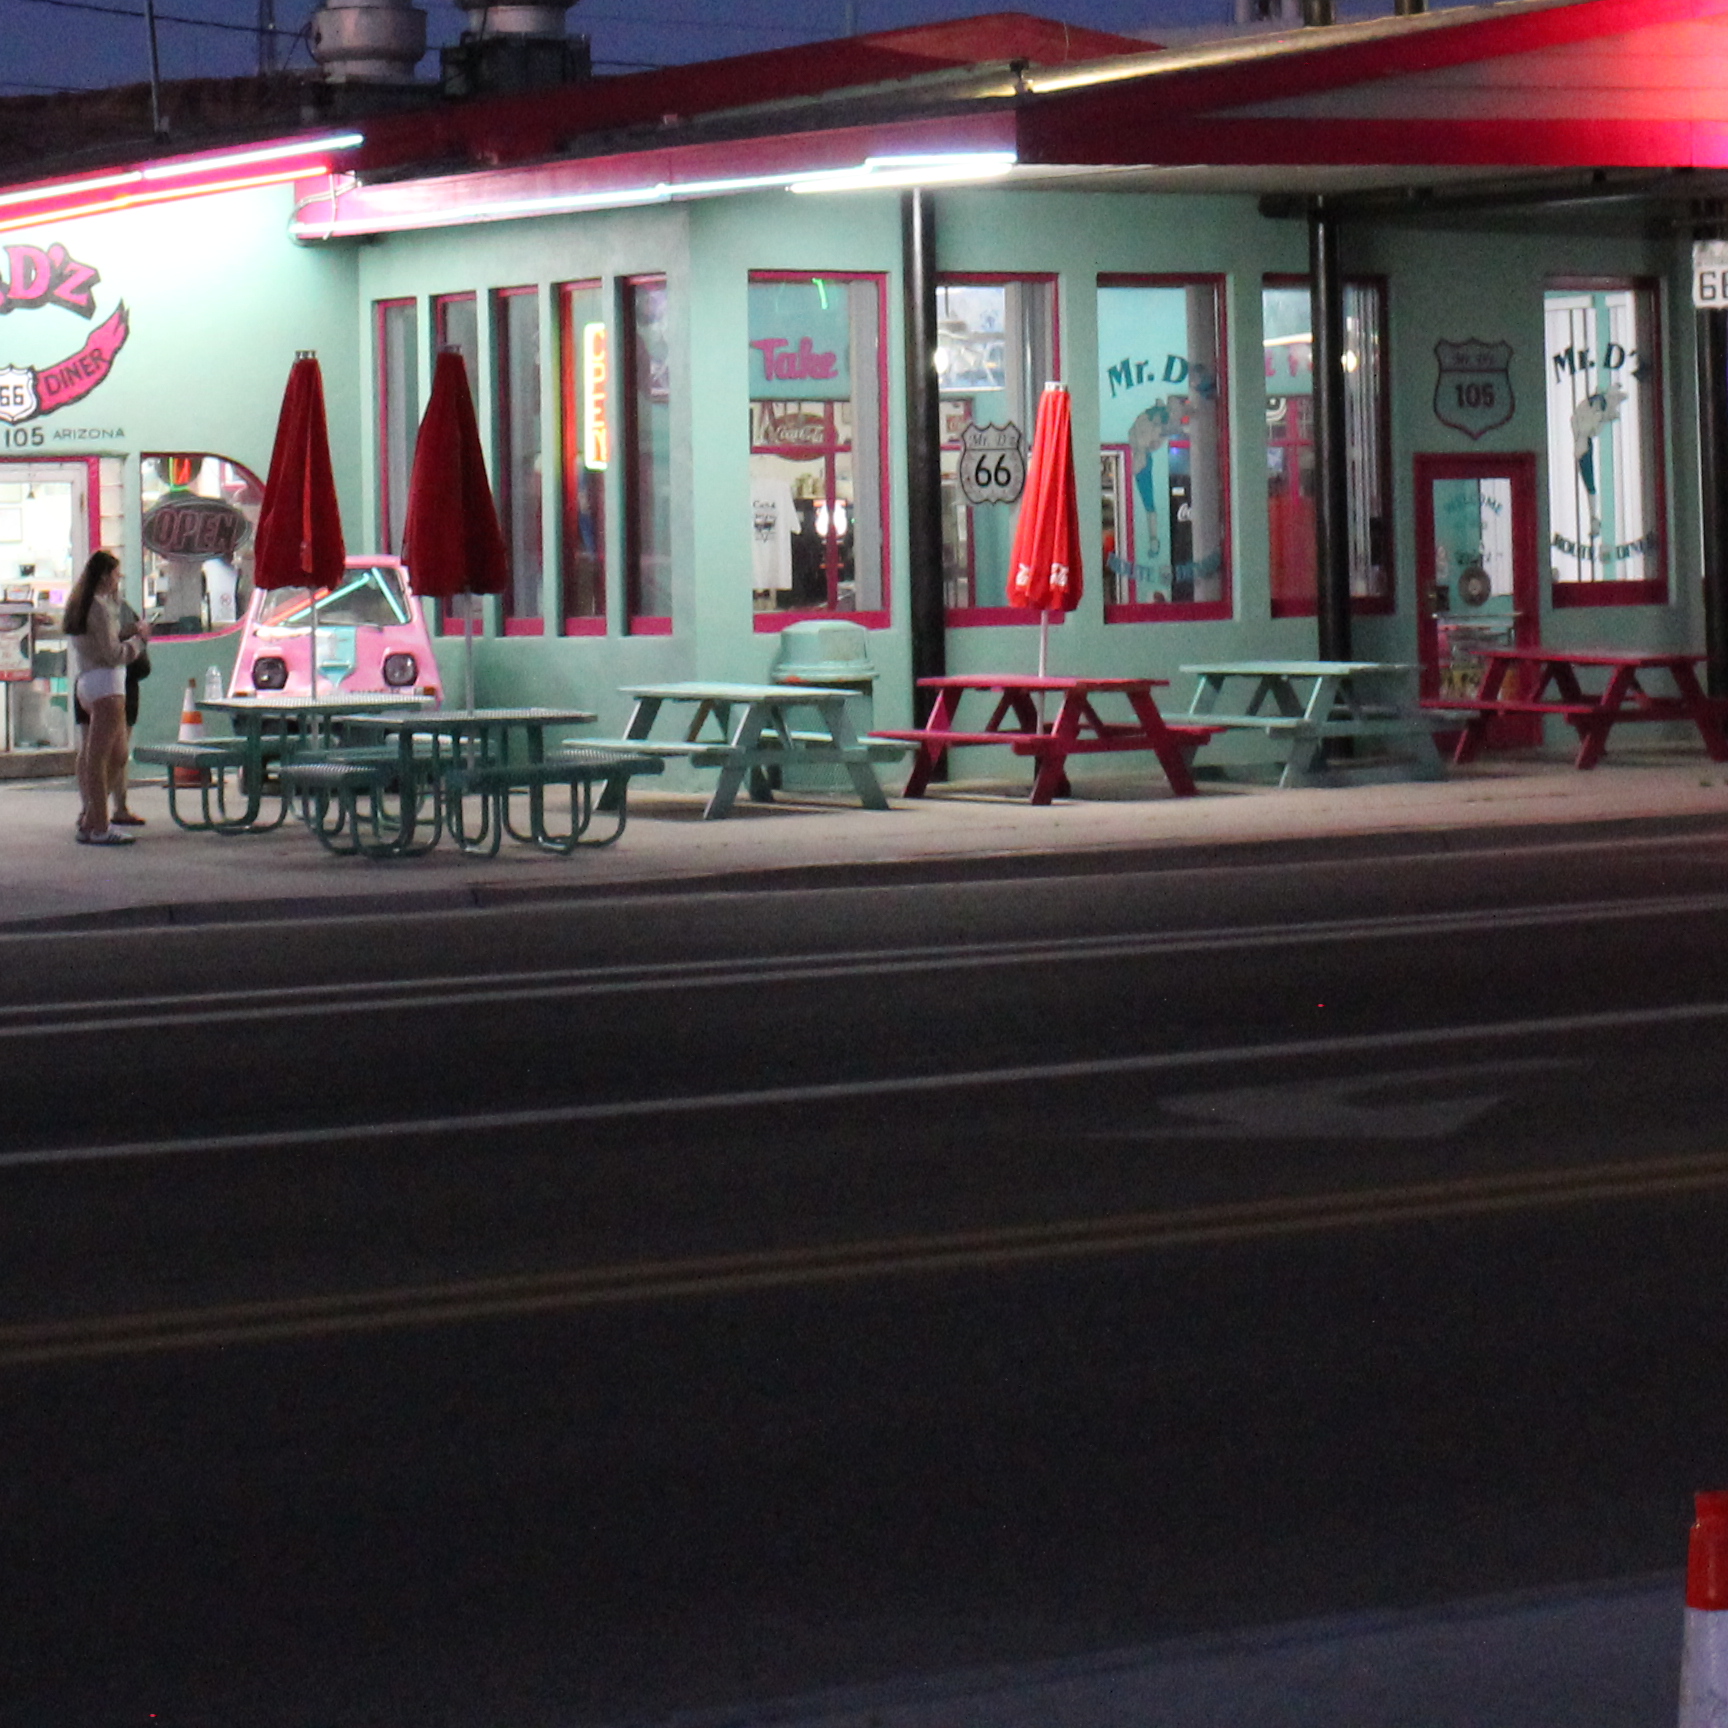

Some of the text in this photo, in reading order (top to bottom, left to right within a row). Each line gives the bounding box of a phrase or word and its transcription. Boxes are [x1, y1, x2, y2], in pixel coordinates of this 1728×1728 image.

[3, 242, 101, 320] D'z
[44, 348, 107, 396] DINER
[750, 337, 839, 381] Take
[1107, 357, 1155, 399] Mr.
[1552, 345, 1595, 384] Mr.
[1455, 382, 1495, 408] 105
[4, 427, 45, 448] 105
[53, 427, 125, 440] ARIZONA
[975, 454, 1011, 487] 66
[152, 507, 240, 556] OPEN
